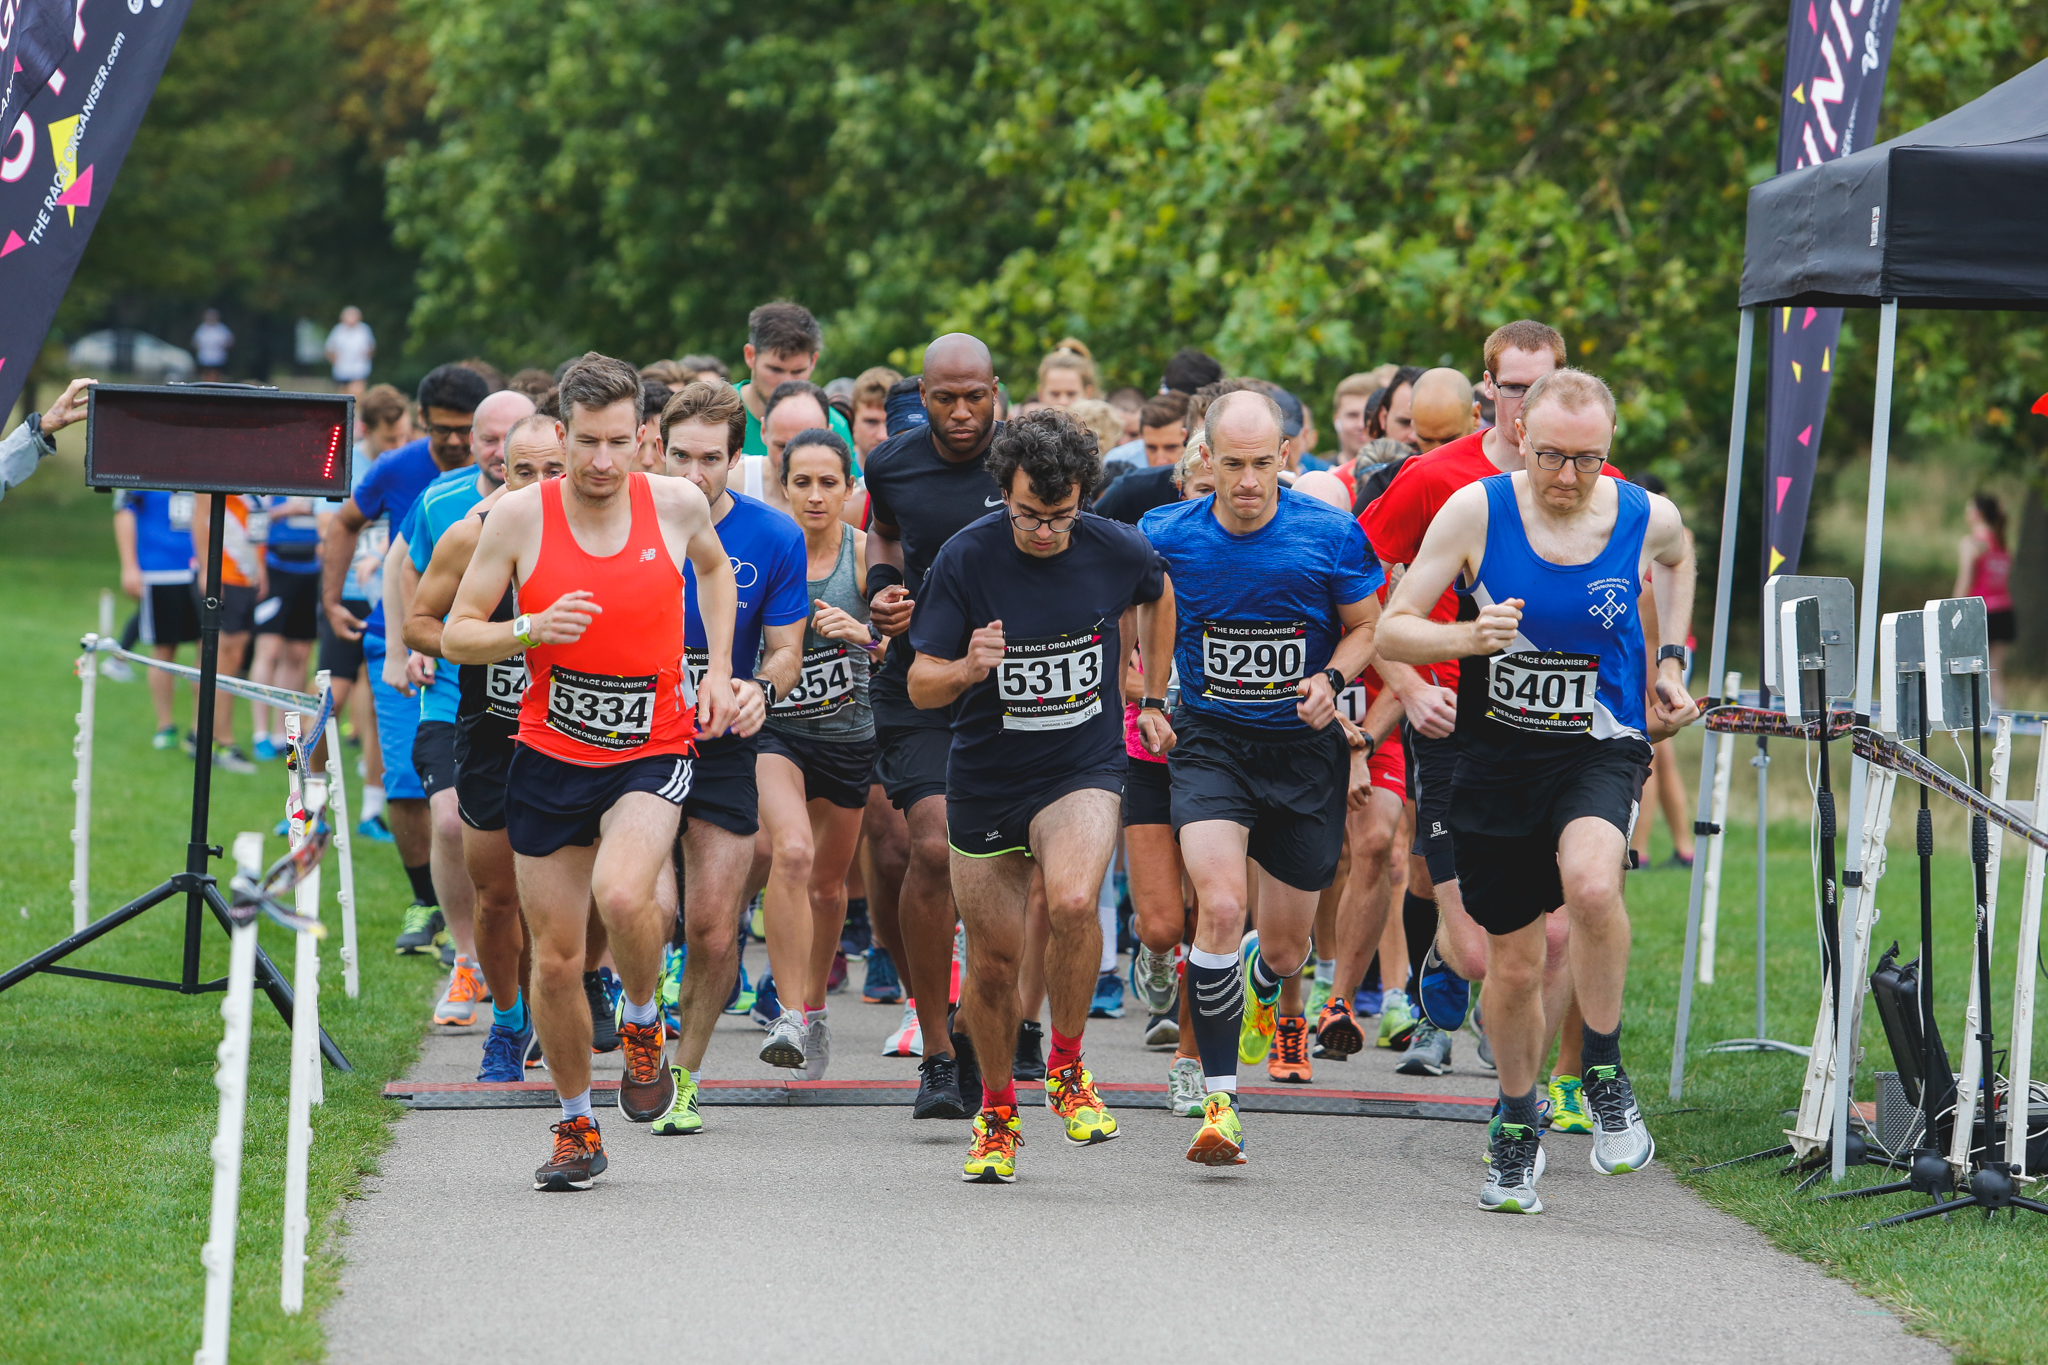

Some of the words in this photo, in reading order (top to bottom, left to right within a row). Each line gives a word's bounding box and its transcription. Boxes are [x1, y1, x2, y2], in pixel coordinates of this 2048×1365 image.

[28, 208, 50, 244] THE
[44, 162, 69, 211] RACE
[64, 32, 126, 163] ORGANISER.com
[1212, 626, 1228, 634] THE
[1229, 627, 1250, 636] RACE
[1251, 626, 1296, 635] ORGANISER
[1007, 645, 1023, 653] THE
[1024, 644, 1046, 652] RACE
[1047, 634, 1093, 650] ORGANISER
[1208, 641, 1300, 678] 5290
[1518, 654, 1541, 664] RACE
[1540, 658, 1589, 666] ORGANISER
[561, 673, 577, 682] THE
[579, 678, 600, 686] RACE
[601, 681, 648, 689] ORGANISER
[1003, 651, 1098, 696] 5313
[1209, 683, 1299, 696] THERACEORGANISER.COM
[1493, 664, 1587, 709] 5401
[553, 685, 648, 729] 5334
[1007, 691, 1098, 713] THERACEORGANISER.COM
[1492, 706, 1588, 727] THERACEORGANISER.COM
[553, 717, 644, 746] THERACEORGANISER.COM
